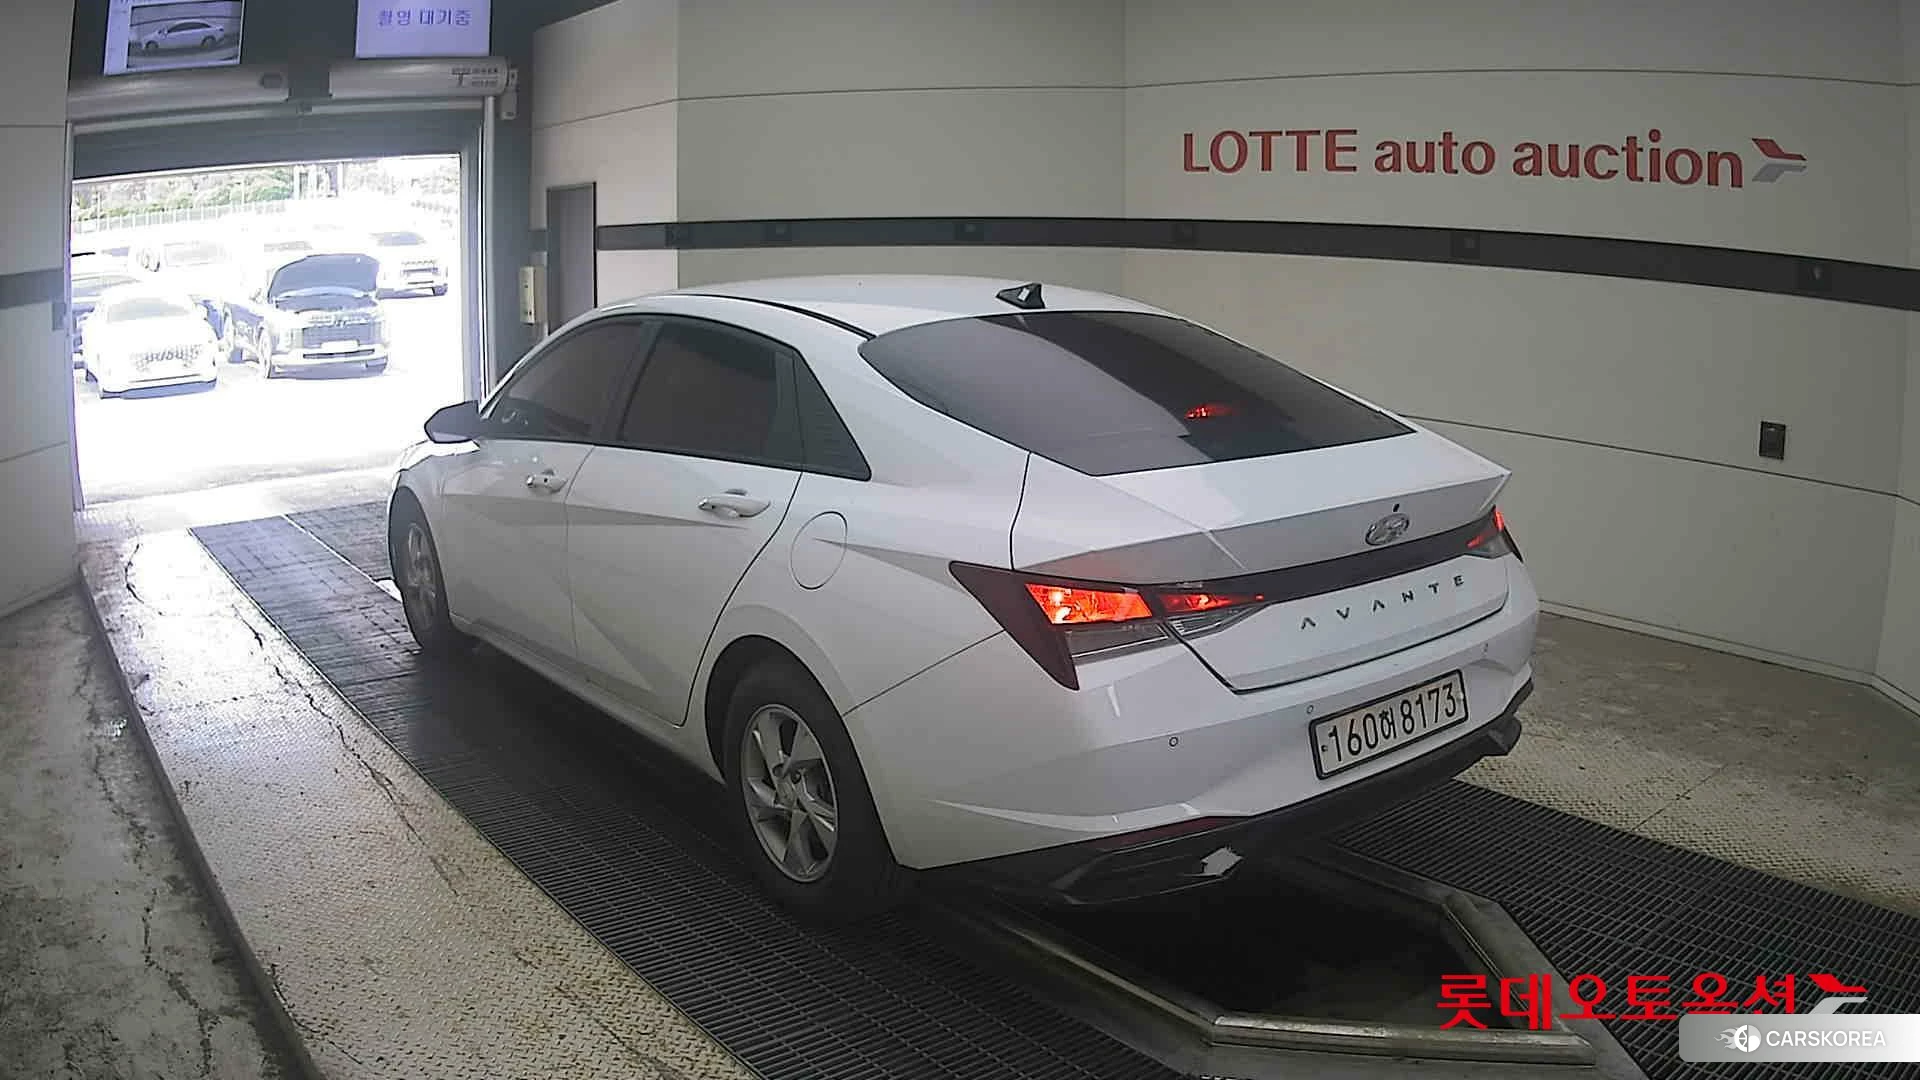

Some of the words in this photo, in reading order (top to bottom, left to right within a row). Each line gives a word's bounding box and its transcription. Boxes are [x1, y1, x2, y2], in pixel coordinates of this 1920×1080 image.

[419, 8, 472, 26] 대기중
[1183, 129, 1358, 173] LOTTE
[1374, 131, 1496, 175] auto
[1512, 129, 1744, 188] auction
[1300, 574, 1465, 630] AVANTE
